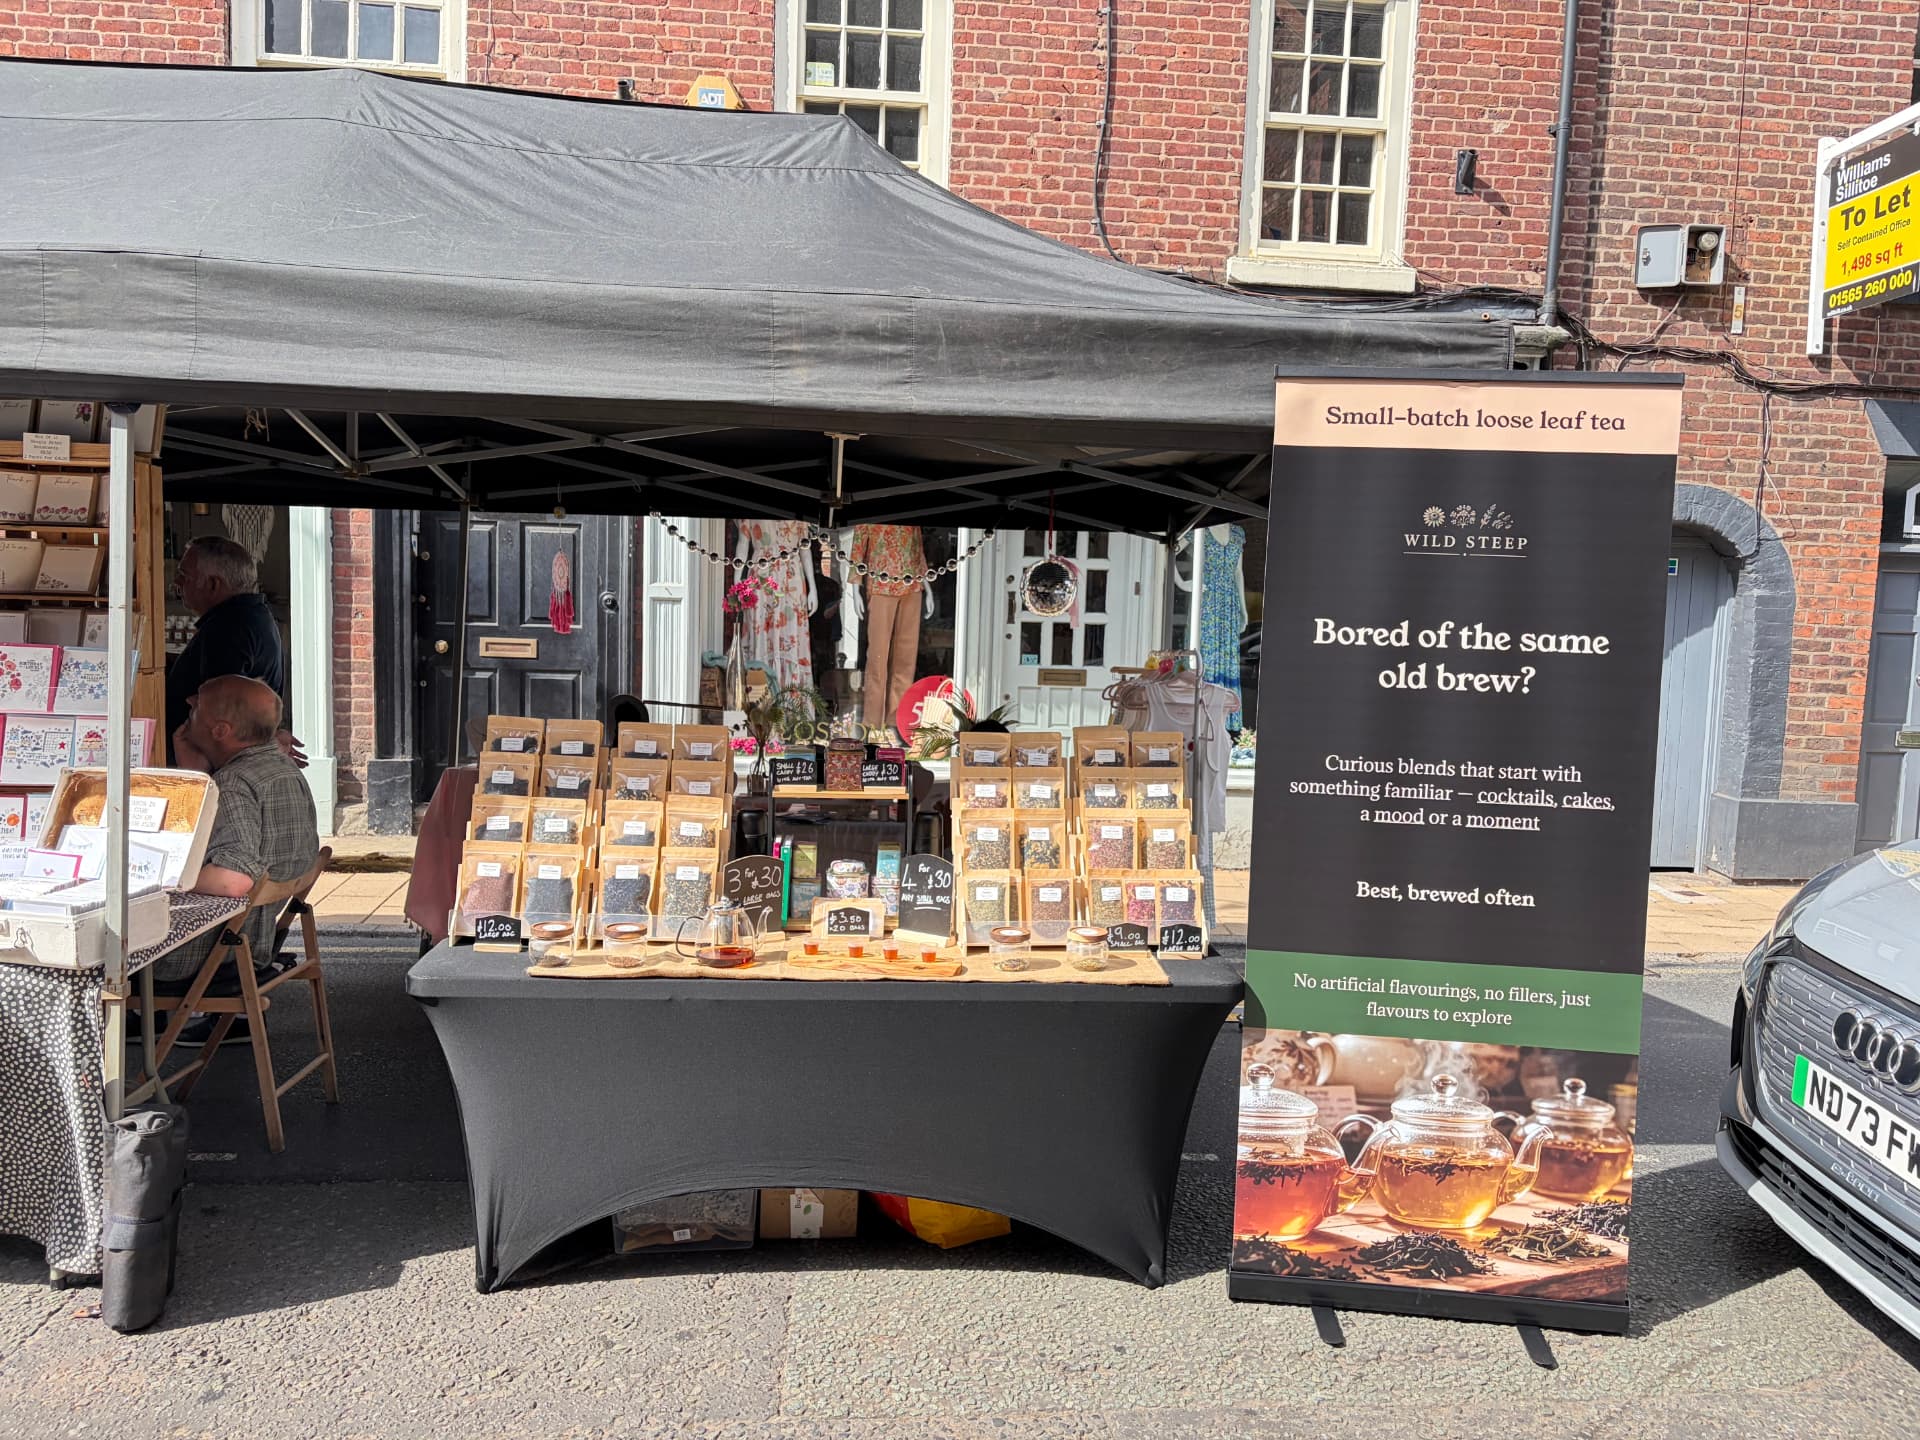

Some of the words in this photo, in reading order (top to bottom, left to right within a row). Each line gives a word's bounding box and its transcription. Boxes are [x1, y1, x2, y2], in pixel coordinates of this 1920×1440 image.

[701, 92, 725, 106] ADT
[1836, 153, 1891, 186] Williams
[1836, 175, 1878, 202] Sillitoe
[1841, 206, 1865, 231] To
[1874, 184, 1911, 219] Let
[1837, 236, 1850, 251] Self
[1852, 226, 1887, 246] Contained
[1889, 219, 1911, 234] Office
[1842, 252, 1871, 276] 1,498
[1876, 248, 1890, 266] sq
[1894, 243, 1903, 258] ft
[1829, 288, 1862, 308] 01565
[1865, 278, 1886, 297] 260
[1889, 270, 1912, 290] 000
[1476, 411, 1533, 429] loose
[1540, 411, 1585, 430] leaf
[1590, 414, 1626, 431] tea
[1404, 533, 1457, 548] WILD
[1466, 535, 1528, 550] STEEP
[1313, 618, 1409, 647] Bored
[1418, 623, 1455, 649] of
[1459, 624, 1511, 652] the
[1520, 631, 1610, 654] same
[1378, 663, 1426, 690] old
[1436, 664, 1536, 694] brew?
[775, 721, 886, 742] LOSSOM
[1325, 754, 1394, 774] Curious
[1398, 757, 1455, 777] blends
[1460, 761, 1494, 779] that
[1499, 764, 1537, 780] start
[1542, 764, 1582, 783] with
[1290, 777, 1381, 800] something
[1384, 781, 1452, 800] familiar
[1477, 786, 1558, 808] cocktails,
[1562, 791, 1615, 811] cakes,
[1360, 810, 1370, 821] a
[1374, 808, 1424, 824] mood
[1428, 813, 1448, 825] or
[1452, 815, 1462, 826] a
[1466, 814, 1540, 830] moment
[728, 869, 741, 892] 3
[752, 866, 781, 889] £30
[902, 864, 917, 890] 4
[928, 870, 951, 889] £30
[743, 894, 763, 903] LARGE
[901, 893, 914, 902] ANY
[1356, 881, 1403, 902] Best,
[1407, 884, 1480, 905] brewed
[1484, 888, 1536, 907] often
[477, 920, 511, 932] £12.00
[1107, 927, 1140, 942] £9.00
[1162, 929, 1200, 945] £12.00
[1294, 973, 1317, 989] No
[1321, 974, 1385, 993] artificial
[1389, 979, 1480, 1002] flavourings,
[1484, 987, 1504, 1001] no
[1508, 985, 1557, 1006] fillers,
[1560, 989, 1591, 1008] just
[1366, 1001, 1430, 1021] flavours
[1433, 1006, 1449, 1021] to
[1453, 1006, 1512, 1027] explore
[1809, 1070, 1880, 1147] ND73
